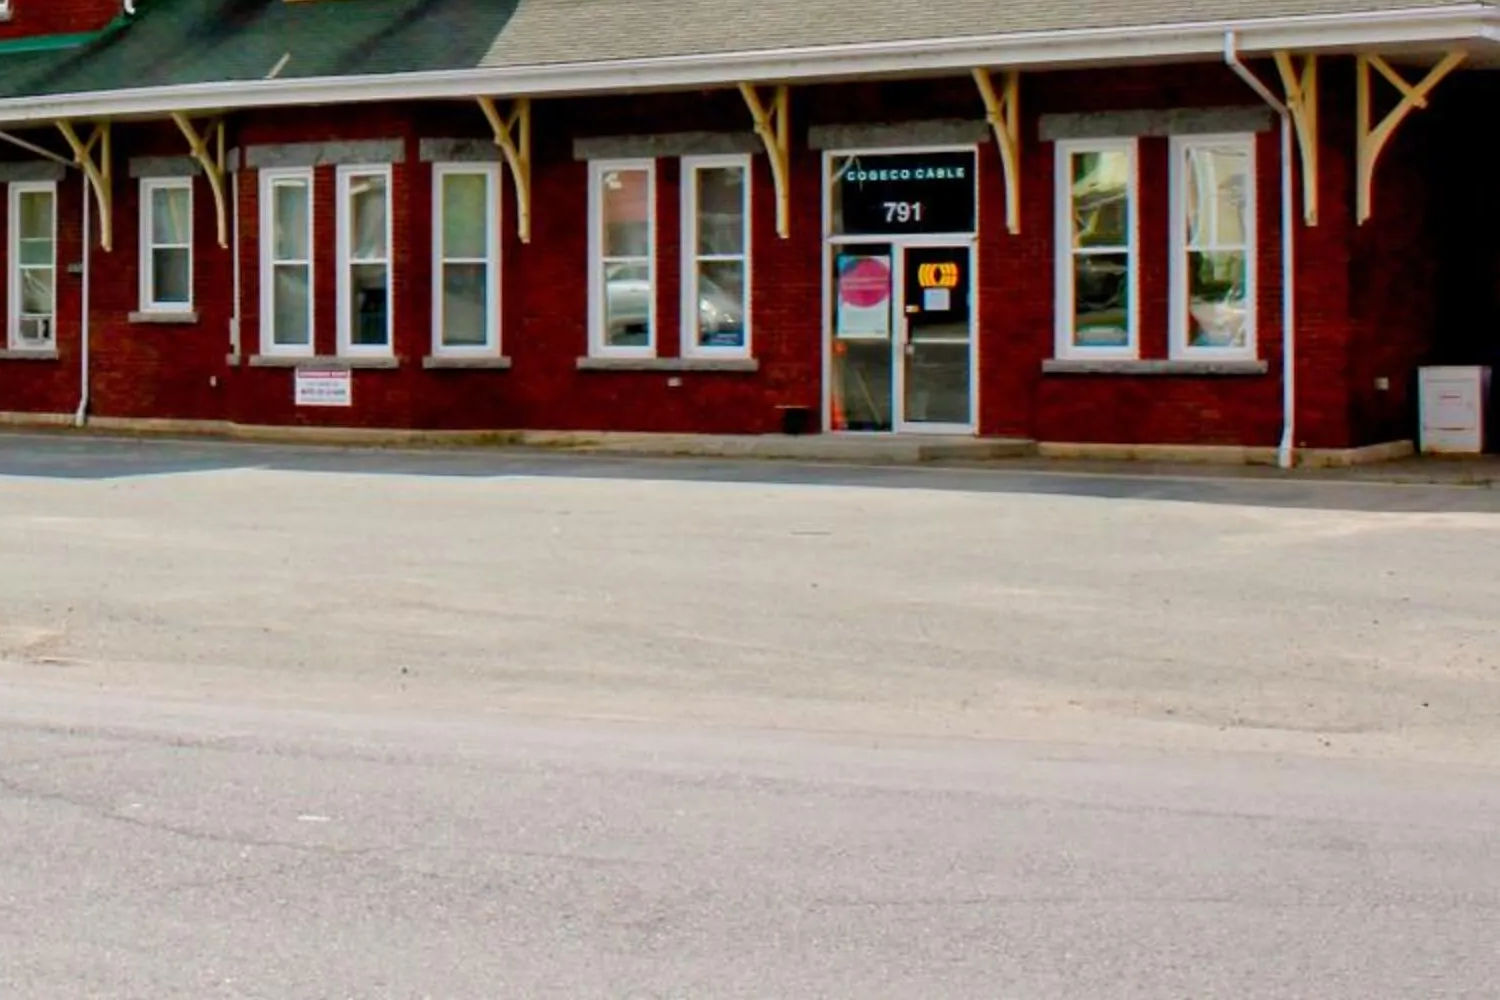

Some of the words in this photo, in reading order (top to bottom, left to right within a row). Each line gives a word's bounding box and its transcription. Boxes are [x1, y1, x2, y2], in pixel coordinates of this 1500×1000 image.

[846, 169, 911, 181] COGECO
[915, 167, 965, 179] CABLE
[883, 201, 921, 223] 791
